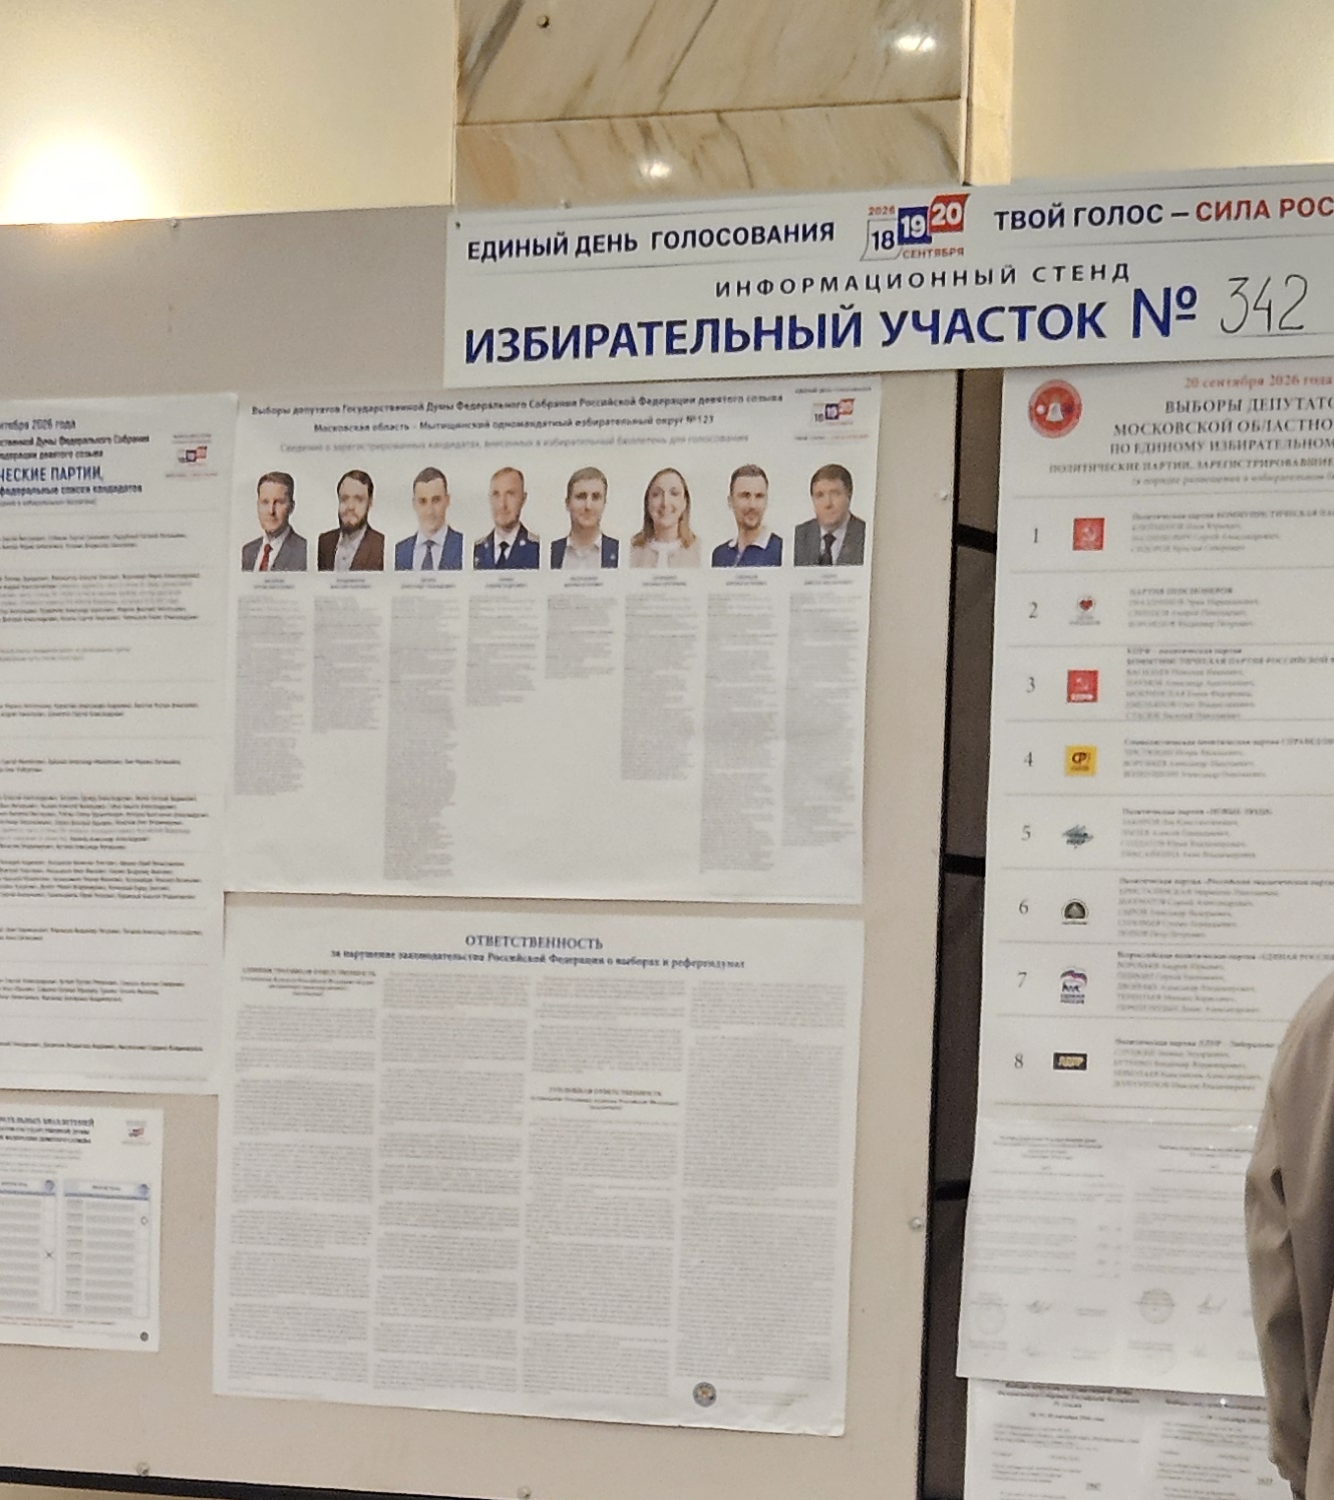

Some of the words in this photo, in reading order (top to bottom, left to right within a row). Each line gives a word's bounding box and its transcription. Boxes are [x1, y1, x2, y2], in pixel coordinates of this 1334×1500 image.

[868, 205, 896, 216] 2026
[994, 202, 1066, 232] ТВОЙ
[1073, 203, 1163, 229] ГОЛОС
[1195, 197, 1271, 223] СИЛА
[871, 230, 895, 252] 18
[901, 214, 926, 238] 19
[931, 202, 963, 225] 20
[468, 231, 568, 262] ЕДИНЫЙ
[575, 235, 638, 259] ДЕНЬ
[651, 222, 835, 250] ГОЛОСОВАНИЯ
[902, 247, 965, 259] СЕНТЯБРЯ
[715, 263, 1017, 299] ИНФОРМАЦИОННЫЙ
[1032, 262, 1131, 284] СТЕНД
[465, 304, 863, 365] ИЗБИРАТЕЛЬНЫЙ
[879, 301, 1108, 349] УЧАСТОК
[1131, 285, 1198, 339] №
[1219, 274, 1309, 335] 342
[1185, 376, 1199, 388] 20
[1202, 374, 1264, 389] сентября
[1269, 374, 1300, 385] 2026
[1303, 375, 1333, 386] года
[1165, 398, 1242, 414] ВЫБОРЫ
[1113, 419, 1233, 437] МОСКОВСКОЙ
[1110, 443, 1130, 455] ПО
[1134, 440, 1206, 454] ЕДИНОМУ
[1033, 528, 1038, 543] 1
[1028, 601, 1038, 618] 2
[1026, 676, 1035, 693] 3
[1024, 751, 1033, 767] 4
[1021, 825, 1032, 841] 5
[1018, 900, 1029, 914] 6
[465, 934, 604, 950] ОТВЕТСТВЕННОСТЬ
[1017, 971, 1027, 988] 7
[1014, 1053, 1024, 1069] 8
